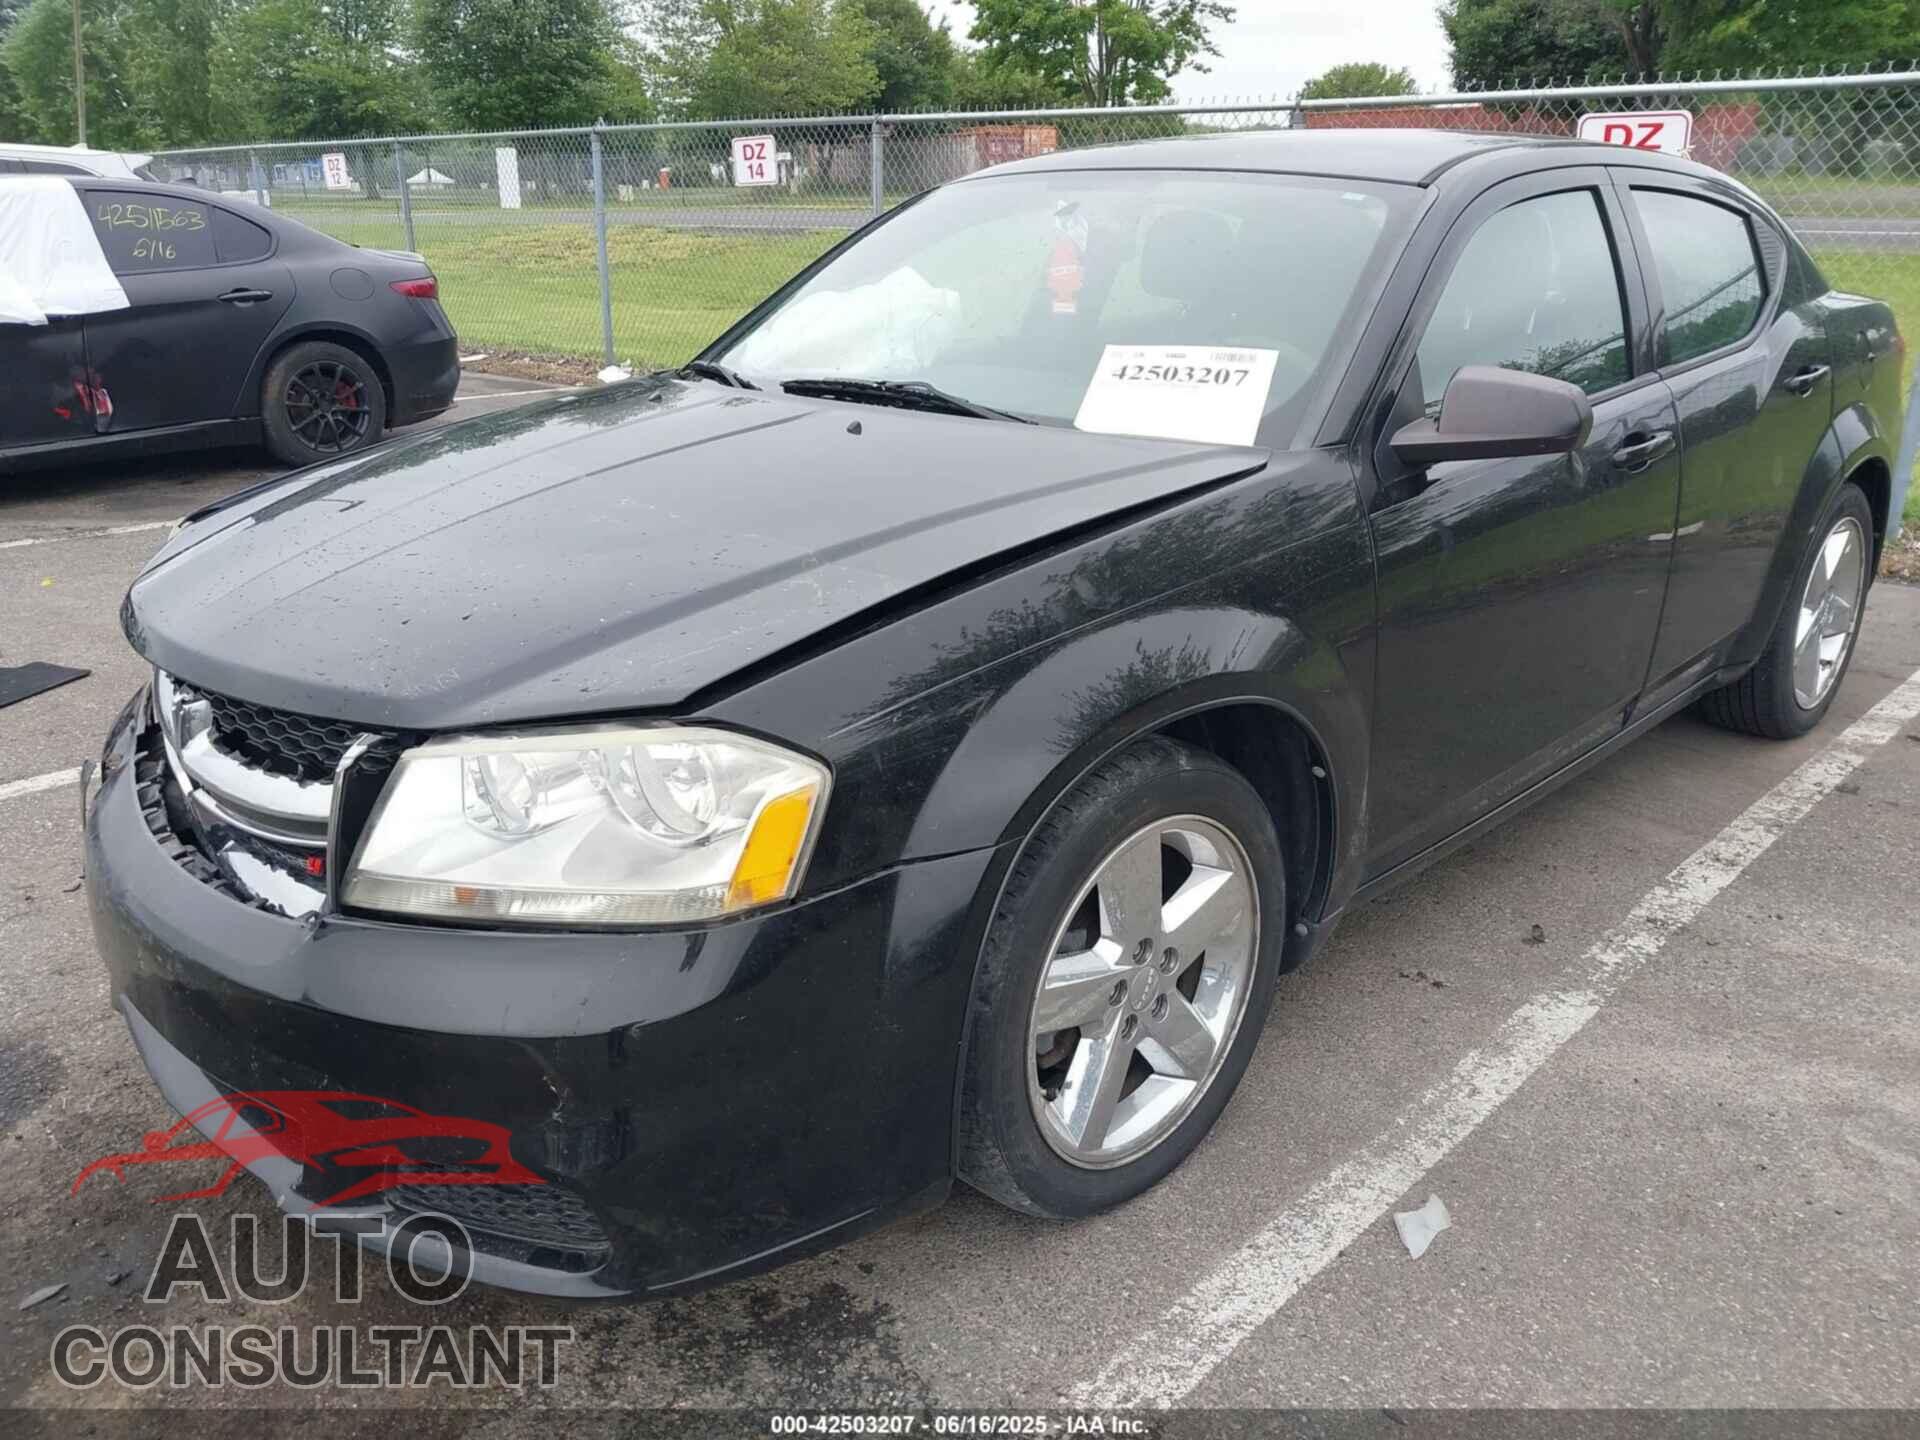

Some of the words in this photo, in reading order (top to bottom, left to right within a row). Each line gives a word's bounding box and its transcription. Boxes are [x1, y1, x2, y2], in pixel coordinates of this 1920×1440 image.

[1603, 122, 1664, 149] DZ
[742, 142, 767, 161] DZ
[327, 158, 341, 171] DZ
[747, 162, 765, 179] 14
[1111, 364, 1250, 387] 42503207
